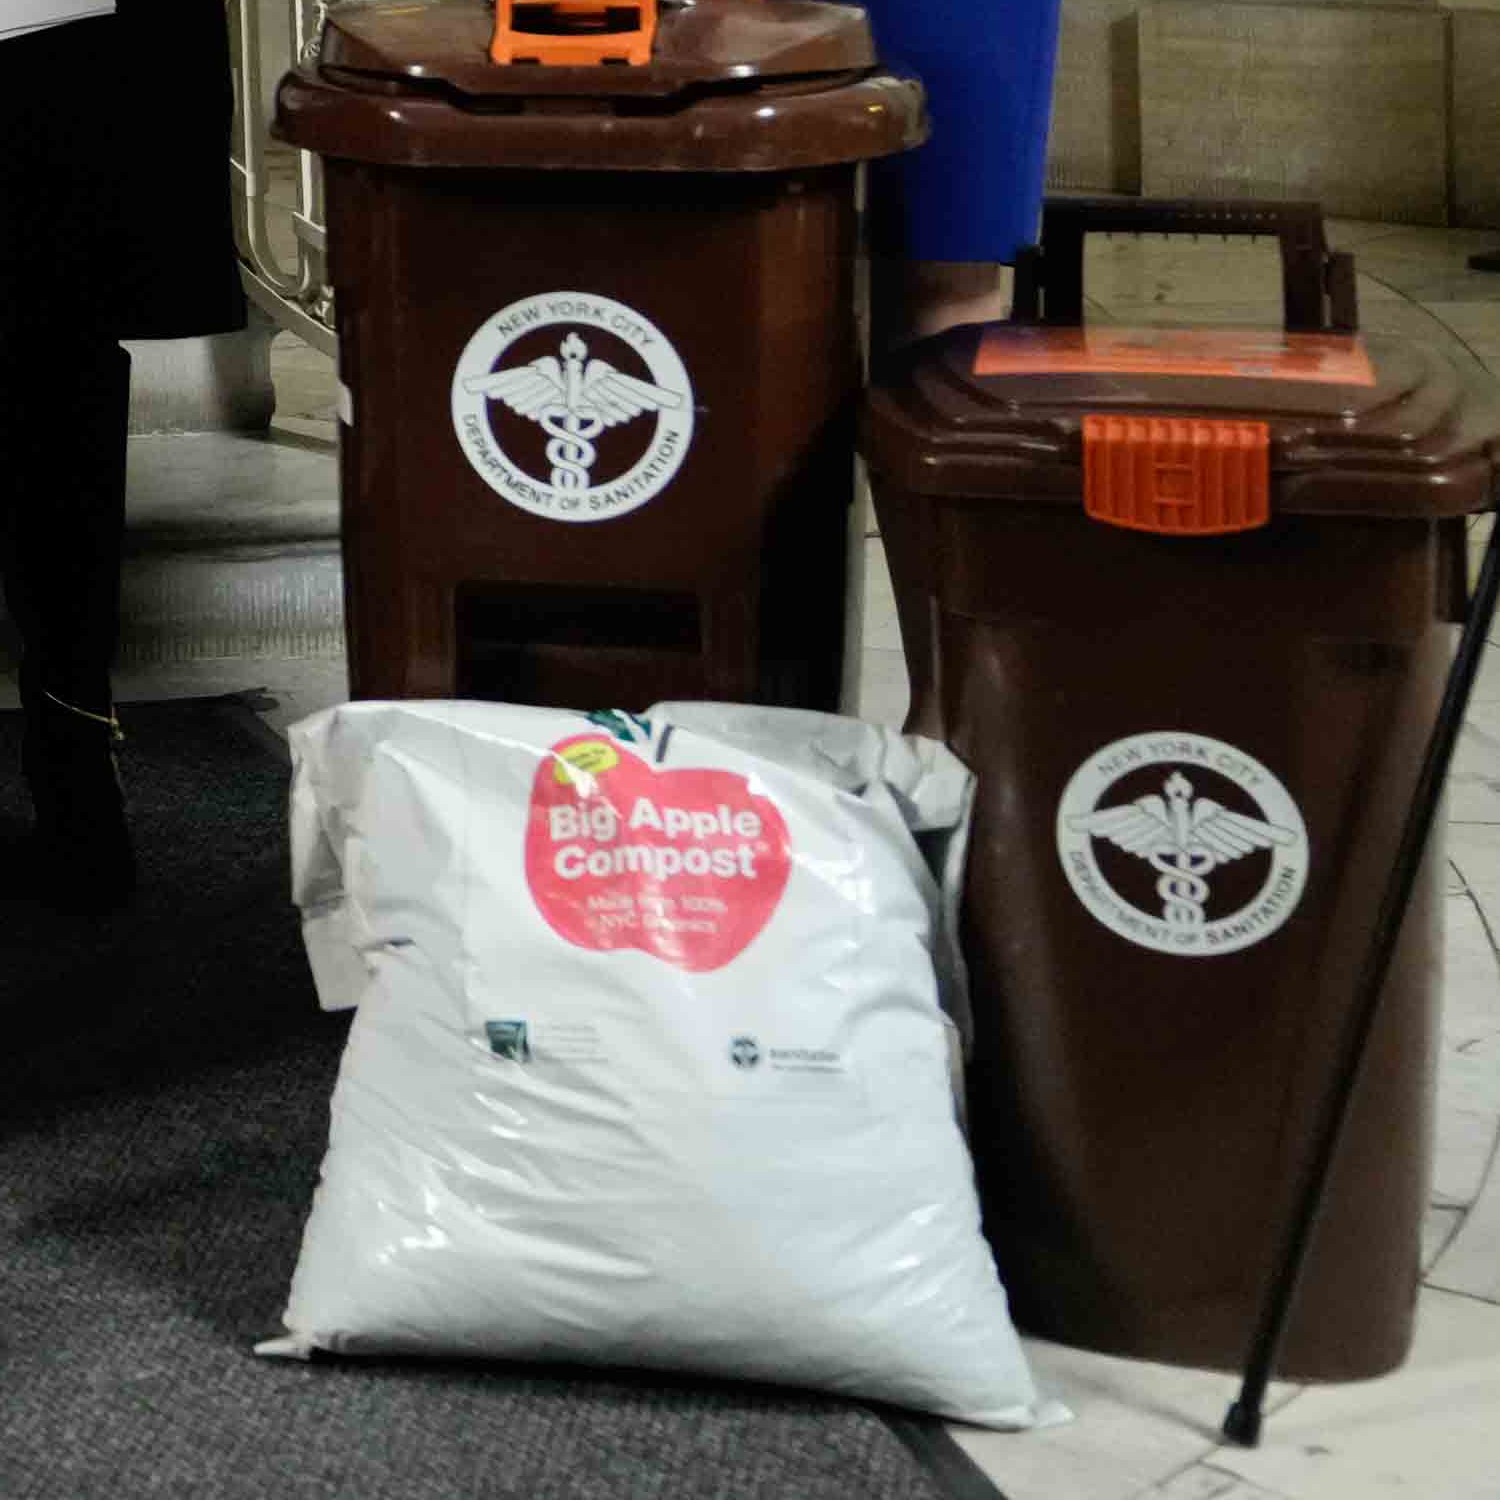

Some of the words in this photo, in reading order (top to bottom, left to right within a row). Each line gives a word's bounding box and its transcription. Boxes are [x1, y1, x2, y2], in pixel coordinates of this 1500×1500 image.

[498, 306, 541, 338] NEW
[549, 300, 605, 320] YORK
[610, 314, 655, 345] CITY
[463, 413, 553, 508] DEPARTMENT
[560, 498, 581, 510] OF
[589, 429, 679, 511] SANITATION
[1098, 748, 1143, 777] NEW
[1150, 741, 1209, 760] YORK
[1217, 754, 1265, 785] CITY
[550, 803, 618, 843] Big
[628, 797, 762, 840] Apple
[1206, 867, 1297, 946] SANITATION
